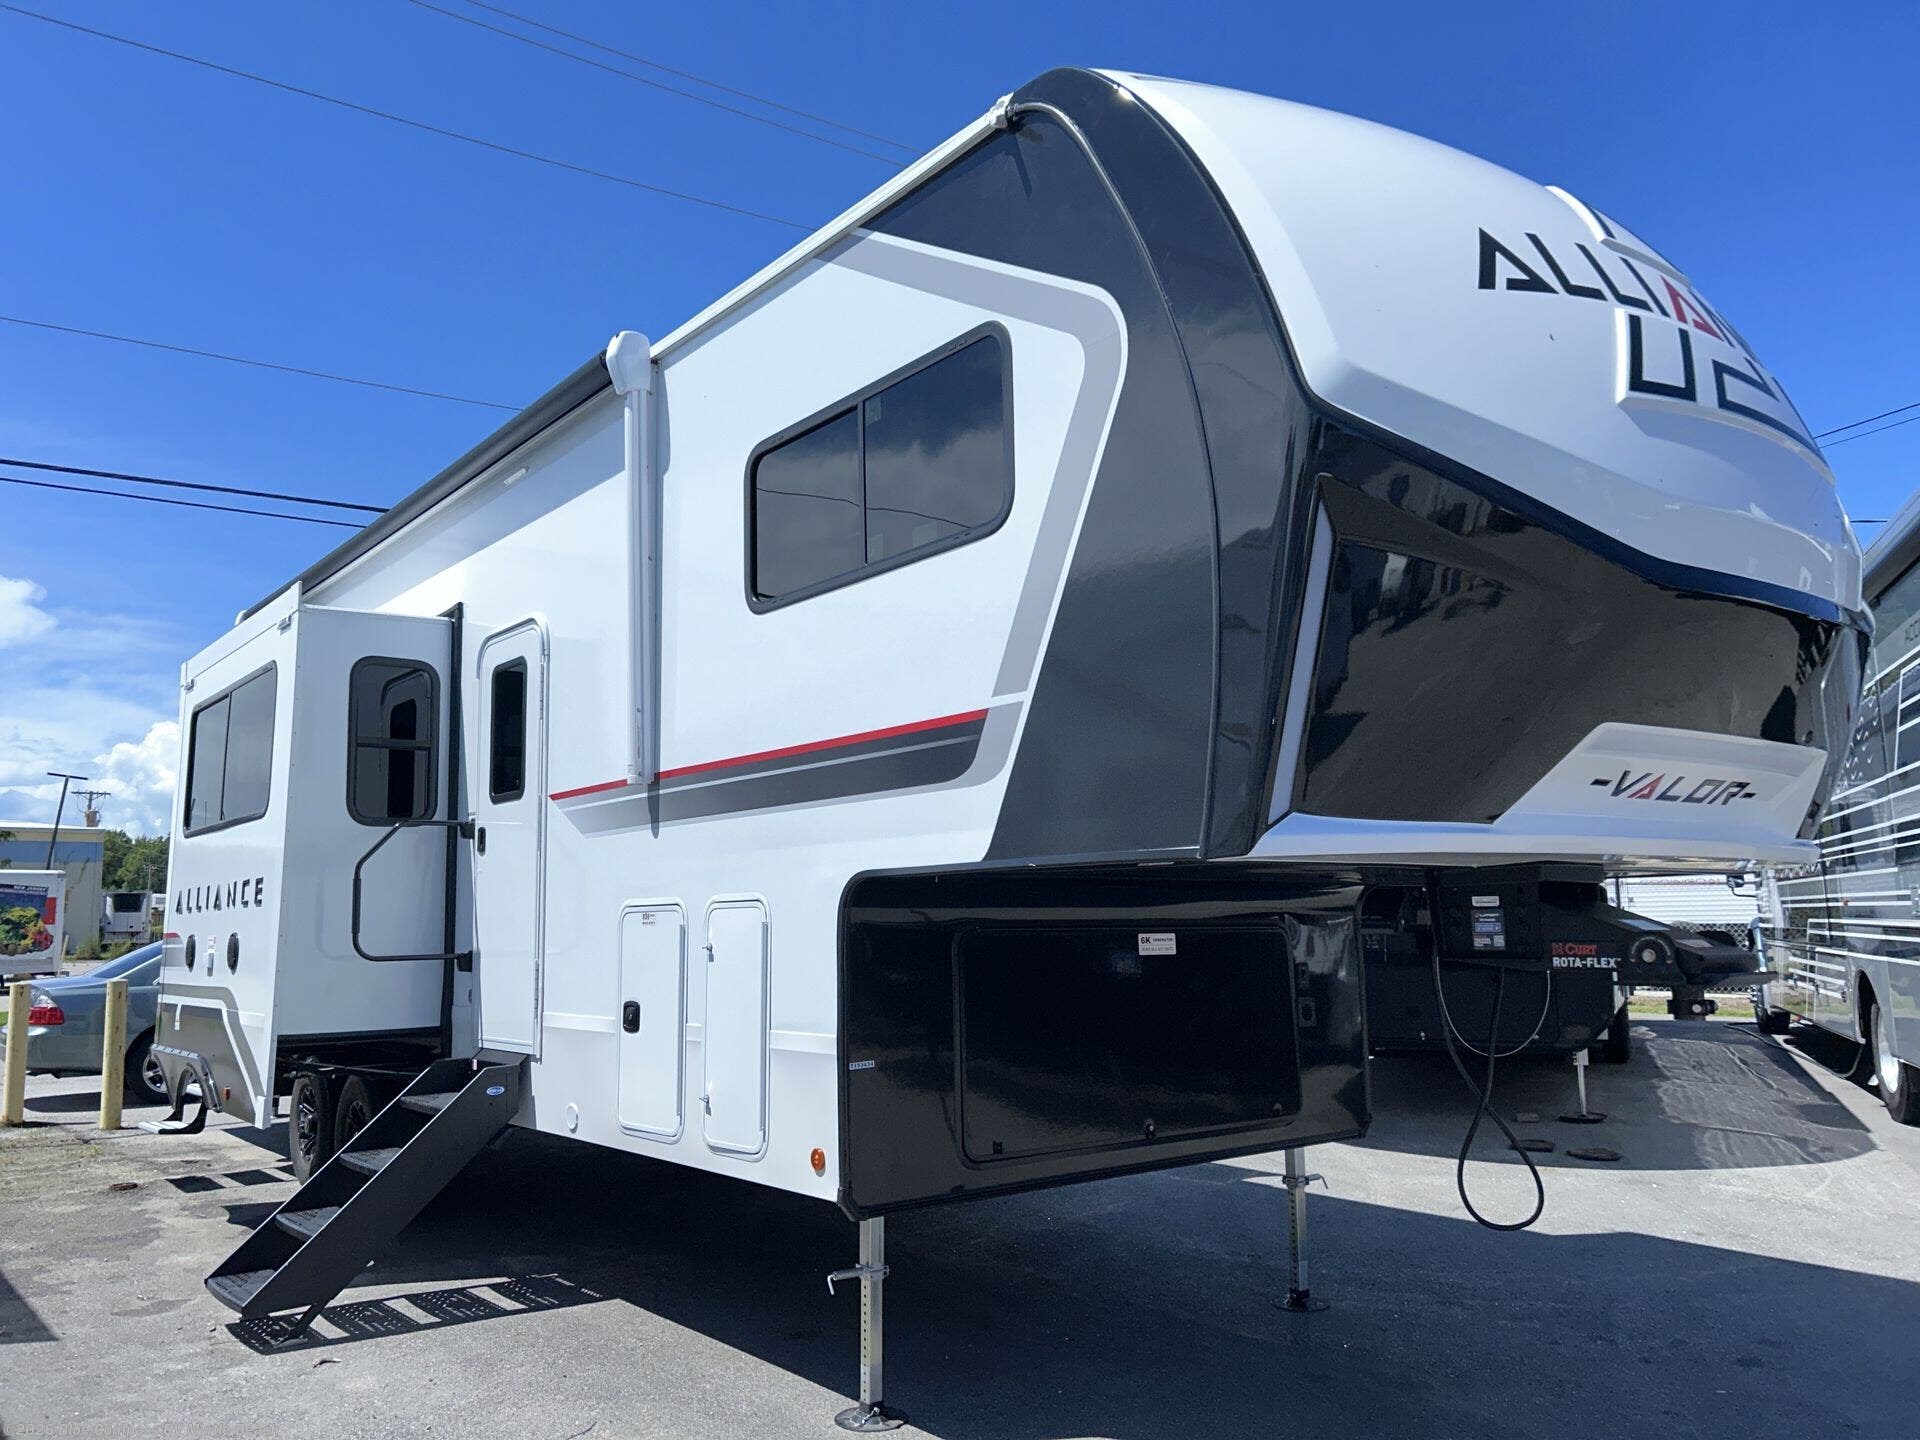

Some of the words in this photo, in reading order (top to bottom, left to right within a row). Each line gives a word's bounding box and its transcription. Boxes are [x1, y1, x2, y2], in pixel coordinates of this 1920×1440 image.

[1478, 226, 1764, 368] ALLIAN
[175, 876, 264, 915] ALLIANCE
[1140, 936, 1151, 945] 6K
[1552, 957, 1617, 969] ROTA-FLEX
